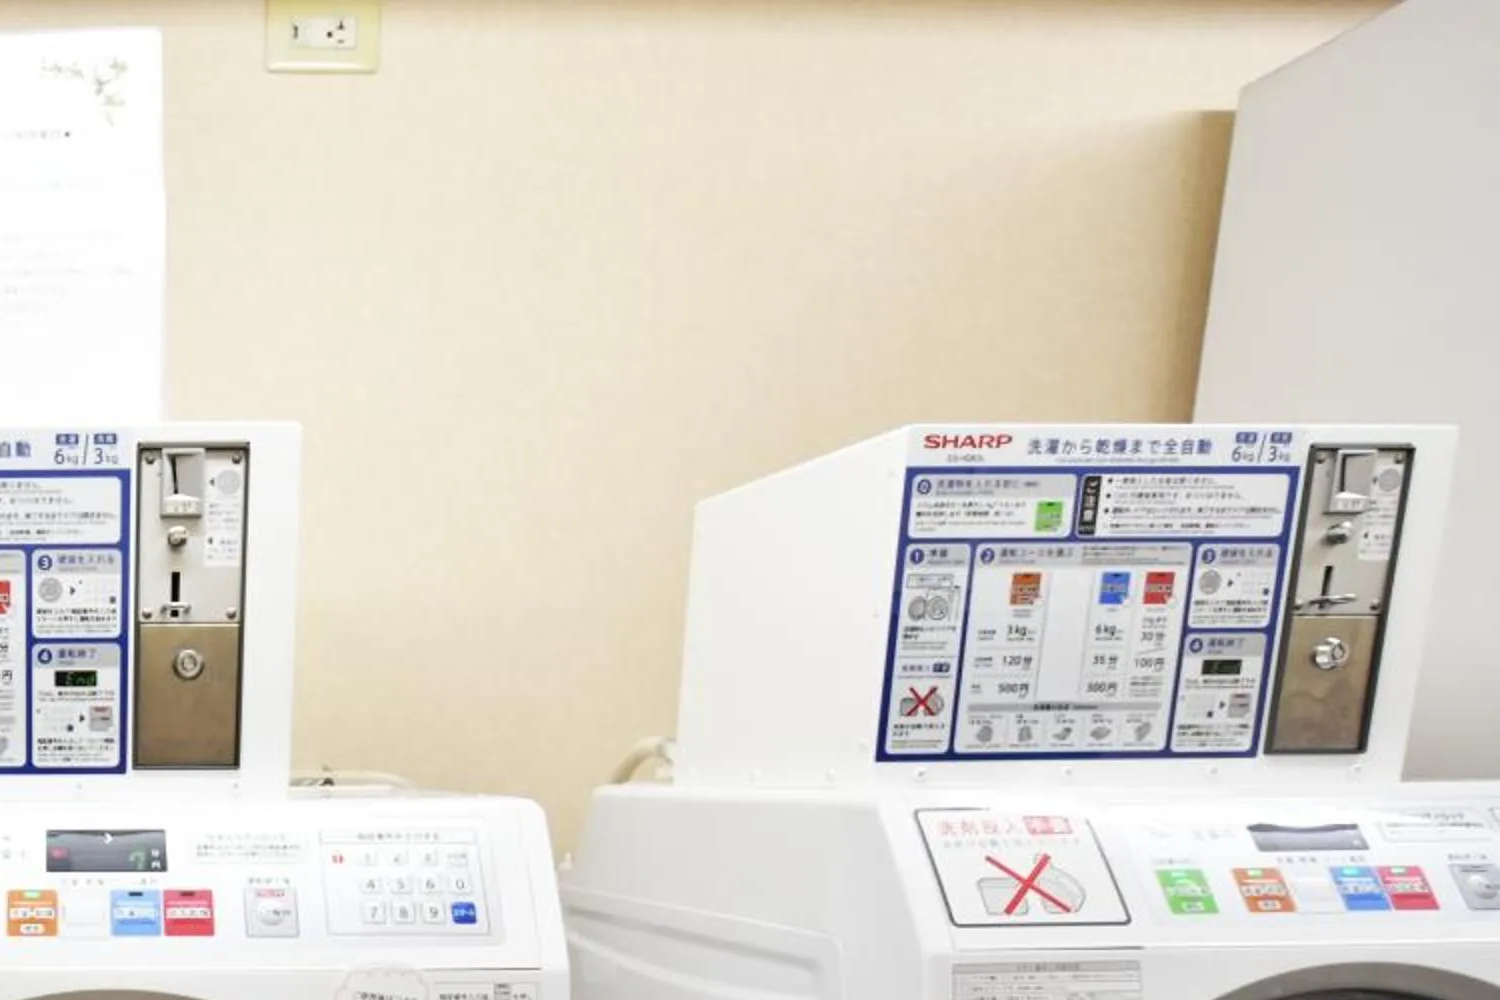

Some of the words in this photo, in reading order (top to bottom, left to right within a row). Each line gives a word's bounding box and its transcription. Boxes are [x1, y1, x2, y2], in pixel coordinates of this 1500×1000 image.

[924, 434, 1013, 449] SHARP
[1028, 438, 1213, 455] 洗濯から乾燥まで全自動
